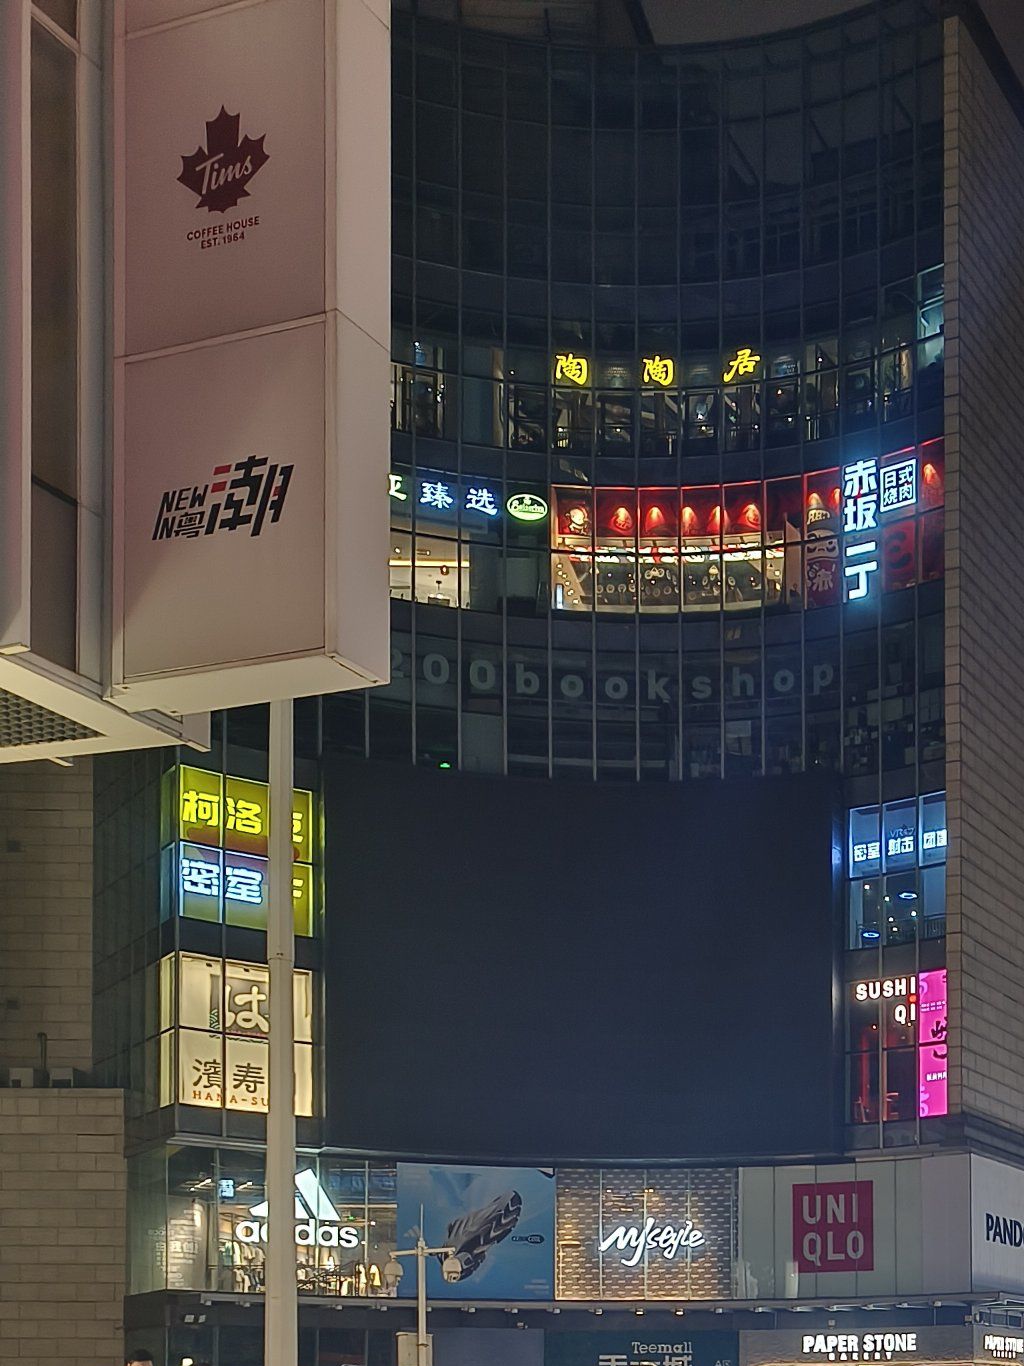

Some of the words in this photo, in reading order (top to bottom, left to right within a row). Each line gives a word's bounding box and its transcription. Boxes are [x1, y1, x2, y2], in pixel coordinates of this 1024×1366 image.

[195, 153, 253, 195] Tims
[186, 224, 224, 241] COFFEE
[226, 216, 260, 231] HOUSE
[200, 236, 221, 249] EST.
[223, 231, 245, 244] 1964
[555, 348, 760, 386] 陶陶居
[884, 466, 913, 488] 日式
[160, 484, 209, 513] NEW
[883, 484, 913, 506] 烧肉
[844, 459, 878, 600] 赤坂一丁
[181, 858, 303, 904] 密室
[856, 976, 916, 1001] SUSHI
[895, 1003, 916, 1025] QI
[802, 1193, 859, 1225] UNI
[235, 1218, 359, 1248] adas
[802, 1230, 864, 1266] QLO
[631, 1341, 694, 1354] Teemall
[802, 1335, 859, 1353] PAPER
[862, 1333, 917, 1352] STONE
